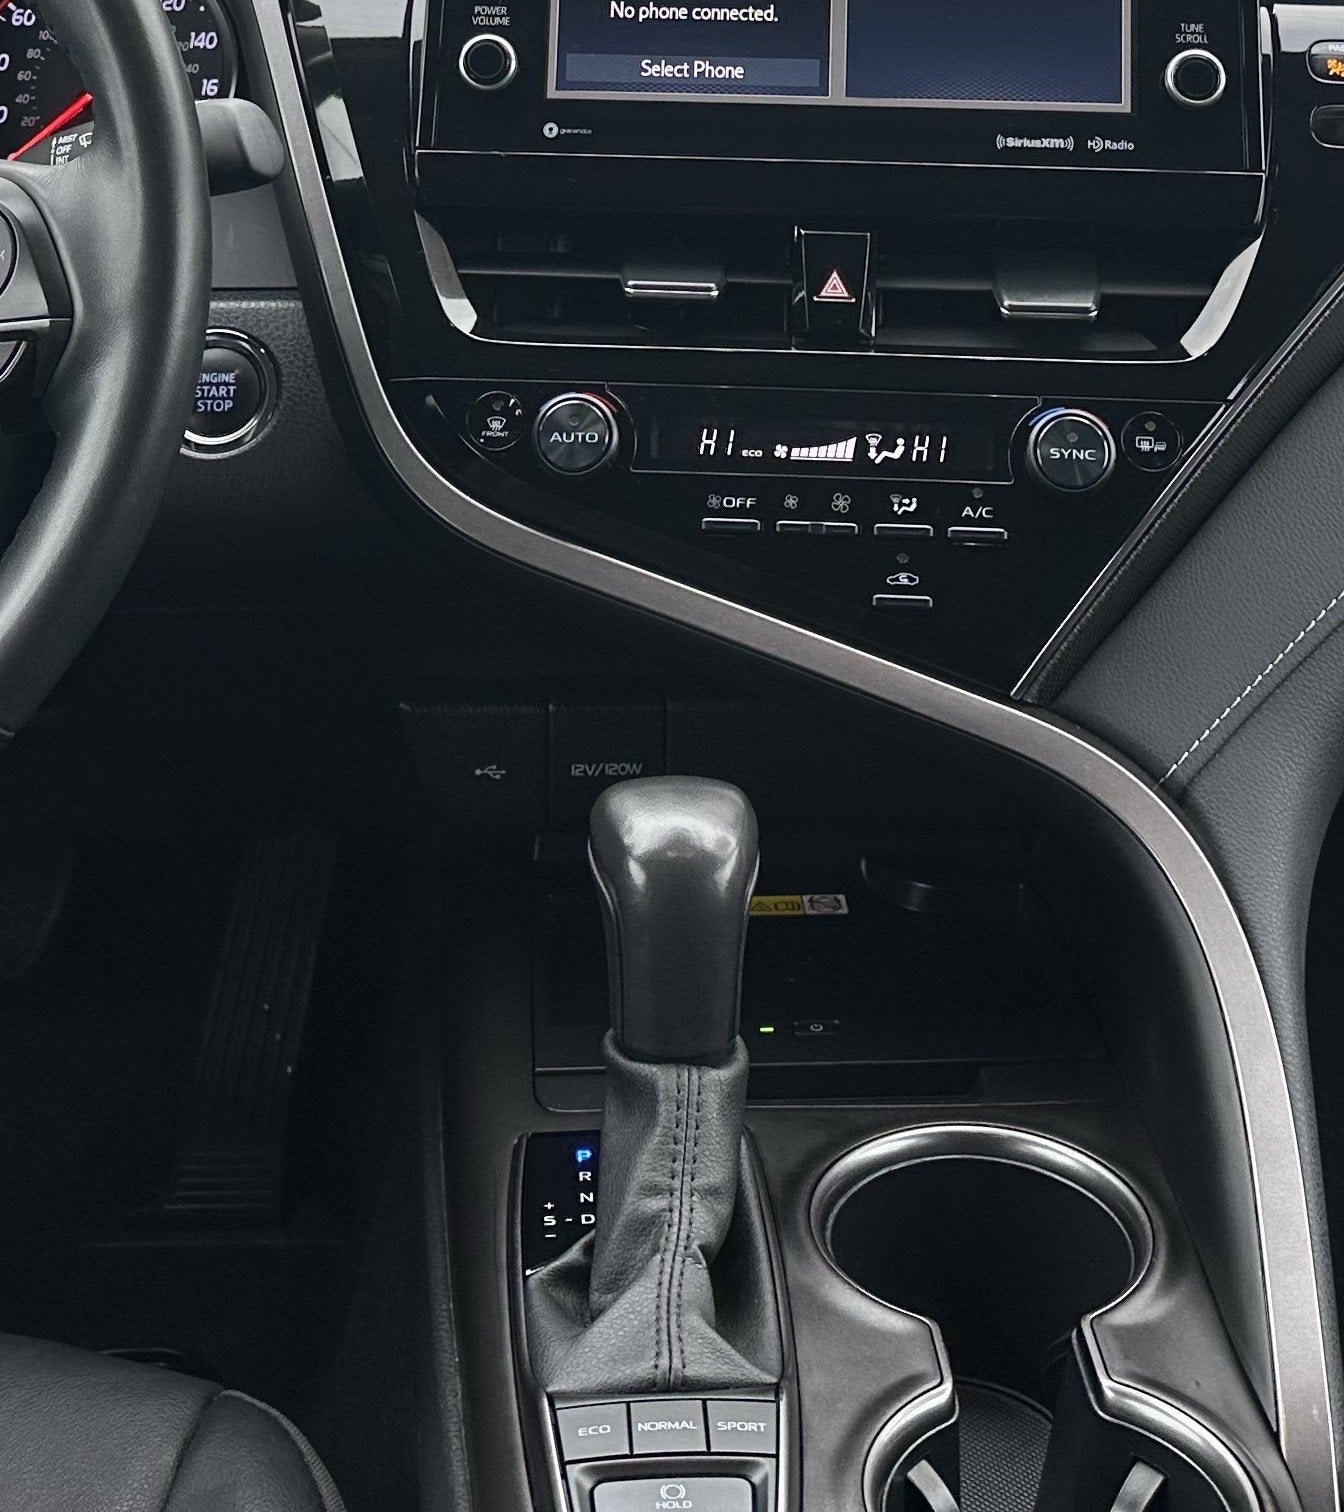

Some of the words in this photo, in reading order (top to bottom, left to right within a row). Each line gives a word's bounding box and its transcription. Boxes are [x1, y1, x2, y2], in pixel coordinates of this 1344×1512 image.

[474, 6, 507, 16] POWER
[609, 1, 635, 20] No
[638, 2, 688, 22] phone
[691, 4, 779, 22] connected.
[11, 9, 35, 26] 60
[471, 16, 511, 26] VOLUME
[1179, 23, 1205, 33] TUNE
[189, 31, 217, 49] 140
[1175, 34, 1209, 44] SCROLL
[26, 48, 41, 59] 80
[640, 59, 690, 78] Select
[693, 60, 745, 79] Phone
[1104, 140, 1134, 150] Radio
[195, 385, 237, 397] START
[197, 399, 234, 412] STOP
[550, 432, 599, 443] AUTO
[1049, 447, 1097, 461] SYNC
[723, 497, 757, 508] OFF
[961, 507, 994, 518] A/C
[570, 763, 643, 777] 12V/120W
[575, 1149, 592, 1162] P
[579, 1171, 592, 1181] R
[579, 1192, 594, 1203] N
[543, 1215, 557, 1226] S
[581, 1214, 596, 1225] D
[577, 1424, 611, 1436] ECO
[637, 1420, 698, 1432] NORMAL
[716, 1421, 766, 1433] SPORT
[656, 1499, 693, 1510] HOLD
